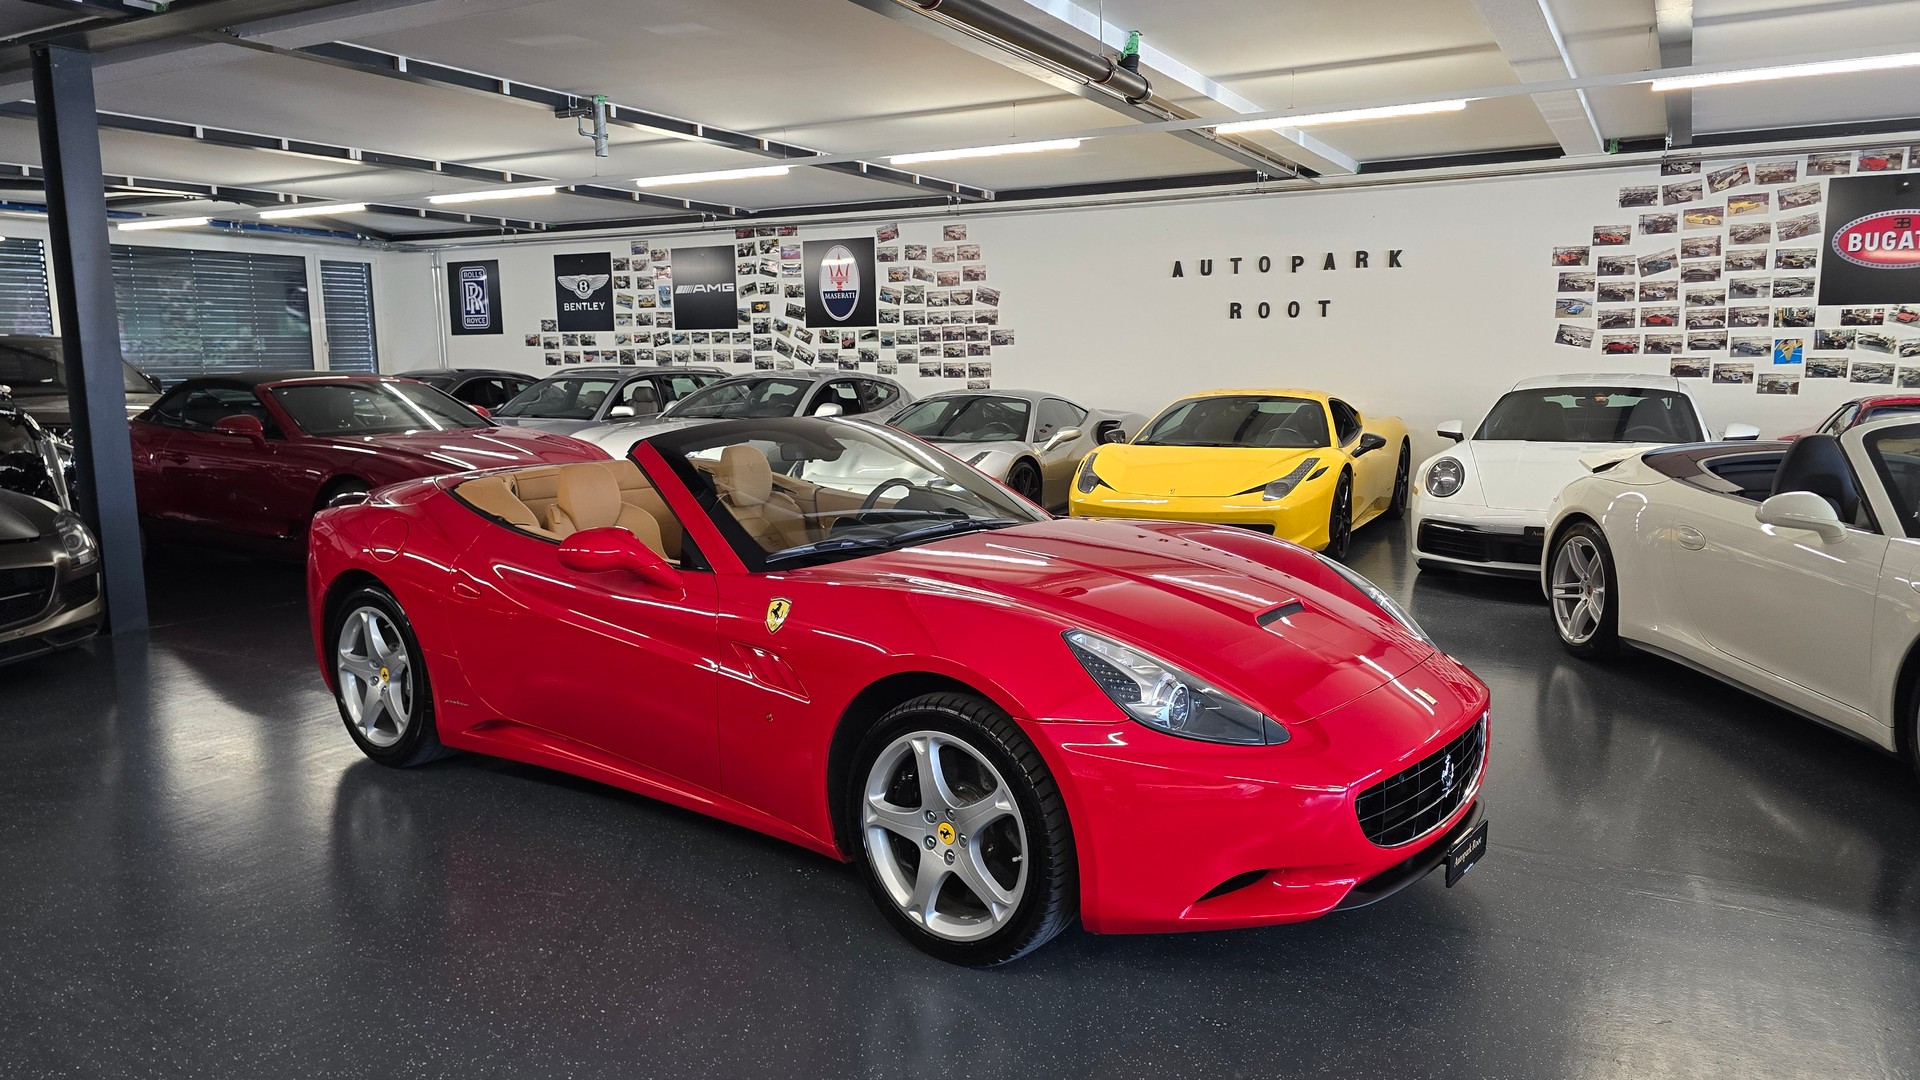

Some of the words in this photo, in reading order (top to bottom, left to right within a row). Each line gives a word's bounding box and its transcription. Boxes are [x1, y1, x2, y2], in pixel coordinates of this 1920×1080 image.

[1848, 230, 1920, 252] BUGA
[1172, 250, 1402, 278] AUTOPARK
[692, 283, 735, 294] AMG
[563, 301, 606, 312] BENTLEY
[1229, 300, 1331, 319] ROOT
